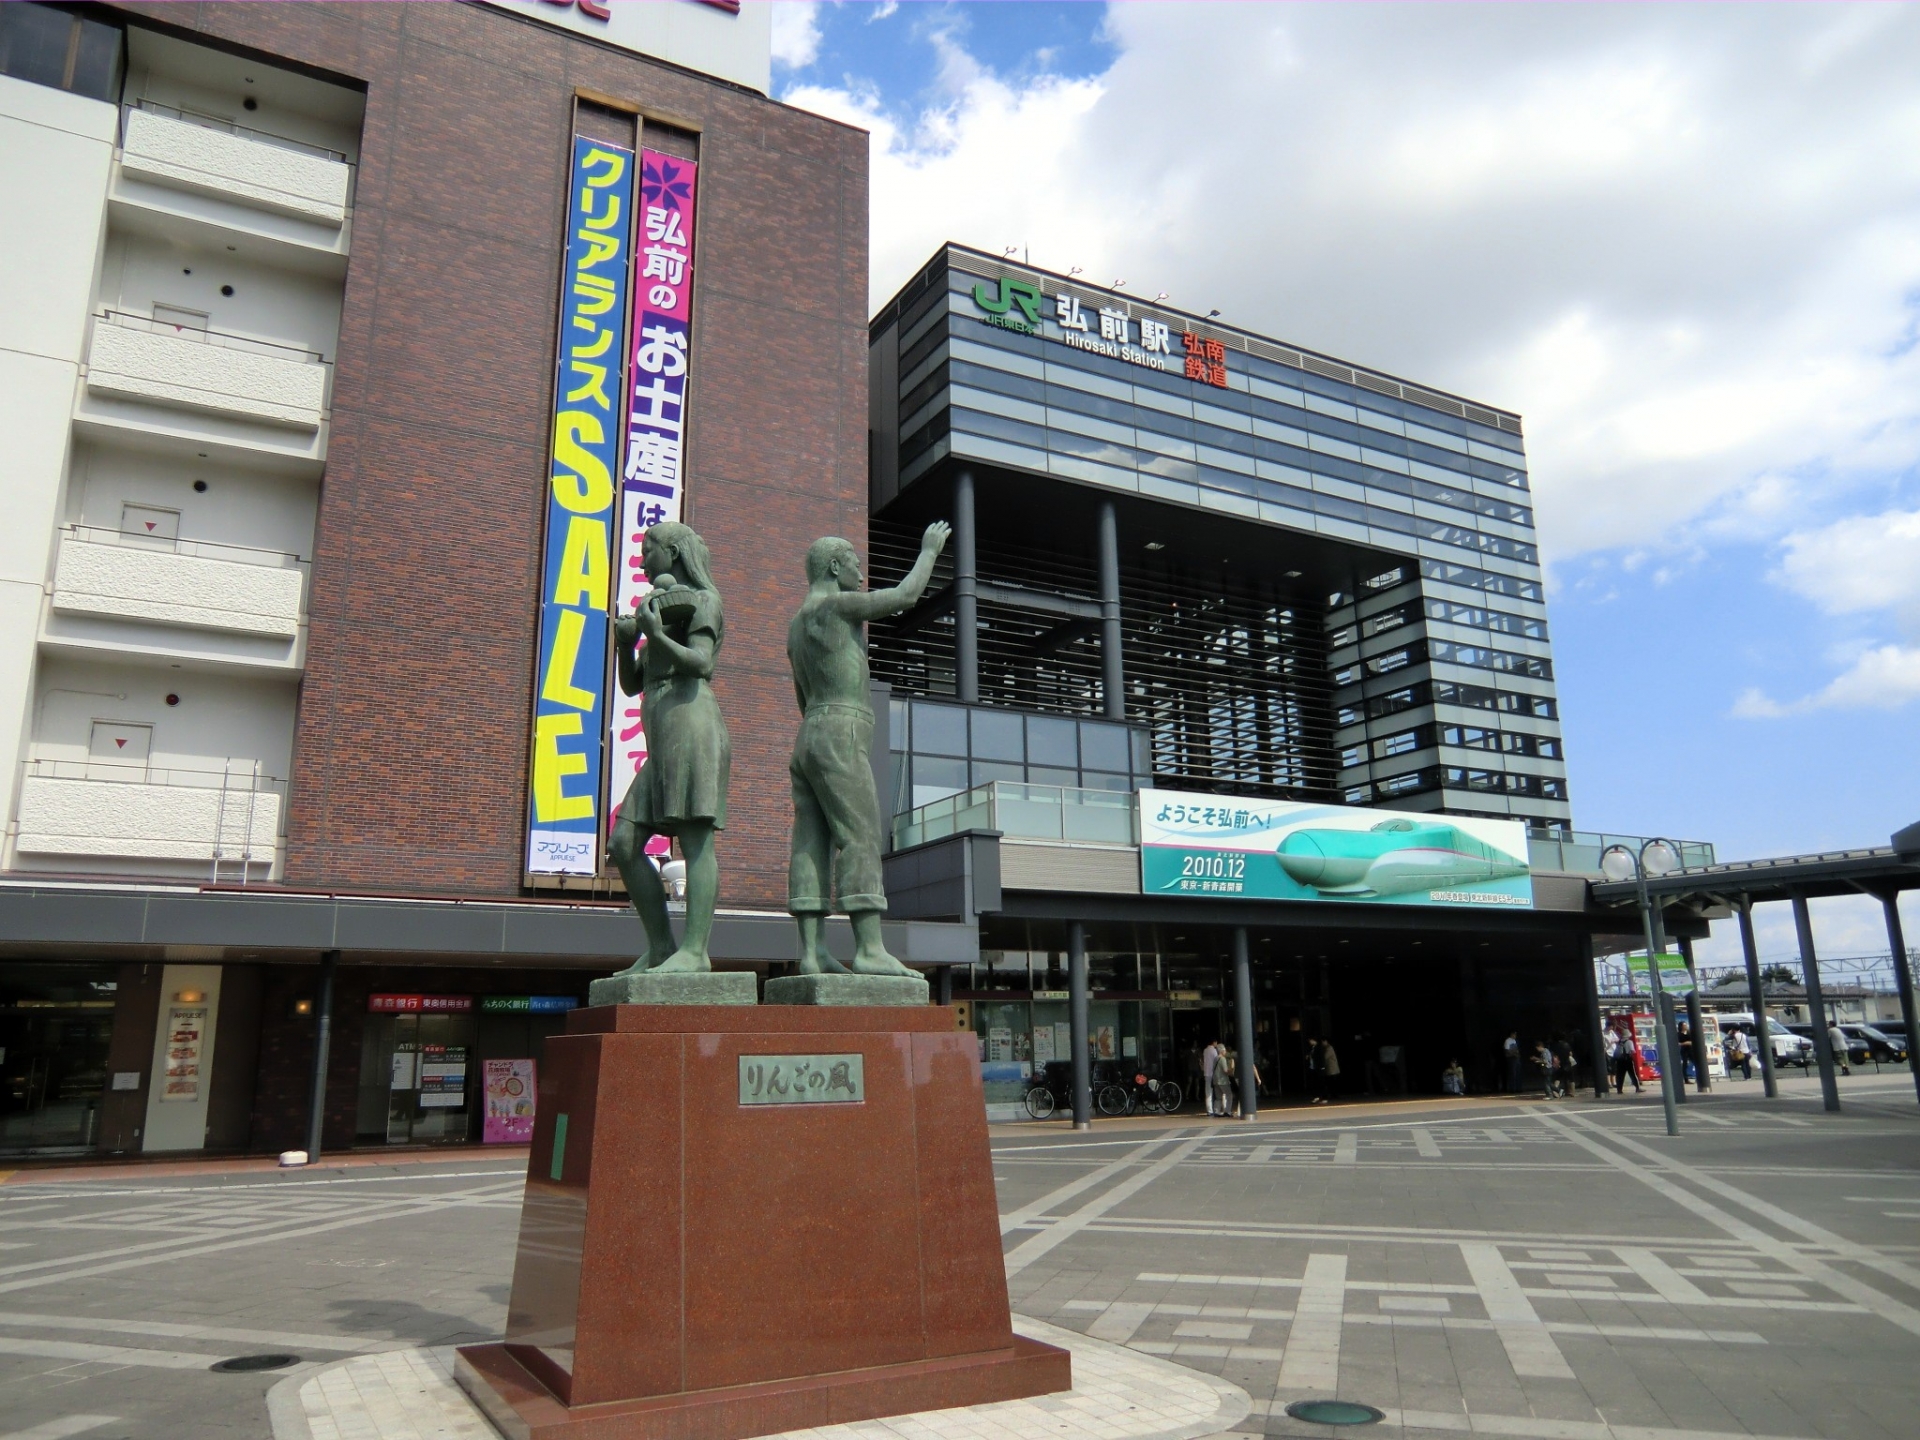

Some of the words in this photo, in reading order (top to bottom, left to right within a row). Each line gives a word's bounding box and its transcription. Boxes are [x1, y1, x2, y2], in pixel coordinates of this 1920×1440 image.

[975, 276, 1042, 323] JR
[1056, 293, 1170, 355] 弘前駅
[1065, 330, 1118, 357] Hirosaki
[1121, 346, 1166, 371] Station
[1182, 856, 1246, 878] 2010.12
[747, 1060, 857, 1096] りんごの風
